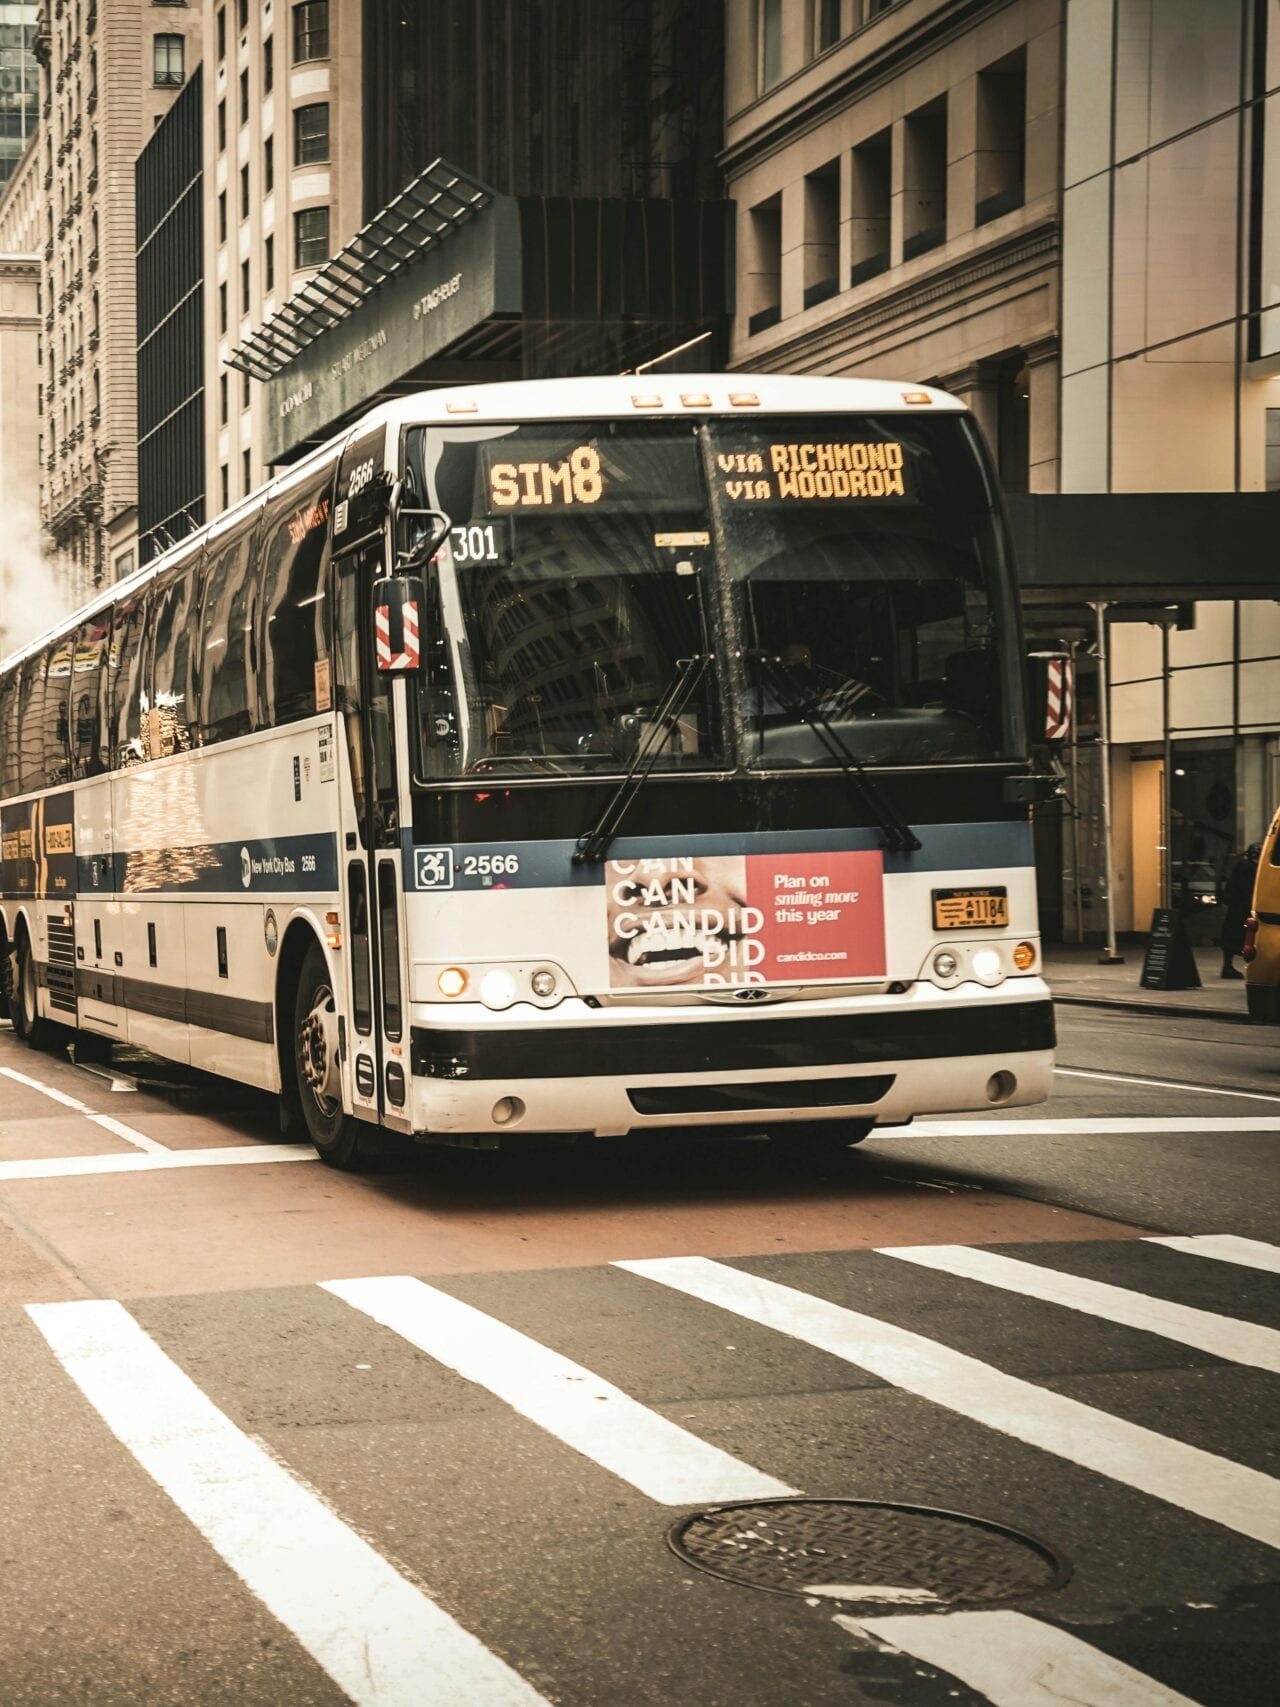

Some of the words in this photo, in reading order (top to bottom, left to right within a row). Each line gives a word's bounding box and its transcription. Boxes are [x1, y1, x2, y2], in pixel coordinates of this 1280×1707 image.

[718, 453, 764, 473] VIA
[770, 442, 904, 472] RICHMOND
[348, 457, 375, 498] 2566
[490, 446, 603, 506] SIM8
[725, 480, 771, 500] VIA
[778, 469, 905, 498] WOODROW
[451, 525, 499, 561] 301
[251, 859, 262, 873] New
[262, 858, 273, 873] York
[273, 857, 284, 876] City
[284, 856, 295, 872] Bus
[464, 854, 519, 875] 2566
[612, 877, 696, 907] CAN
[774, 874, 806, 888] Plan
[809, 876, 830, 888] on
[774, 891, 823, 908] smiling
[825, 891, 859, 903] more
[614, 907, 765, 939] CANDID
[775, 909, 804, 923] this
[807, 909, 841, 925] year
[702, 938, 766, 968] DID
[776, 951, 848, 963] candidco.com
